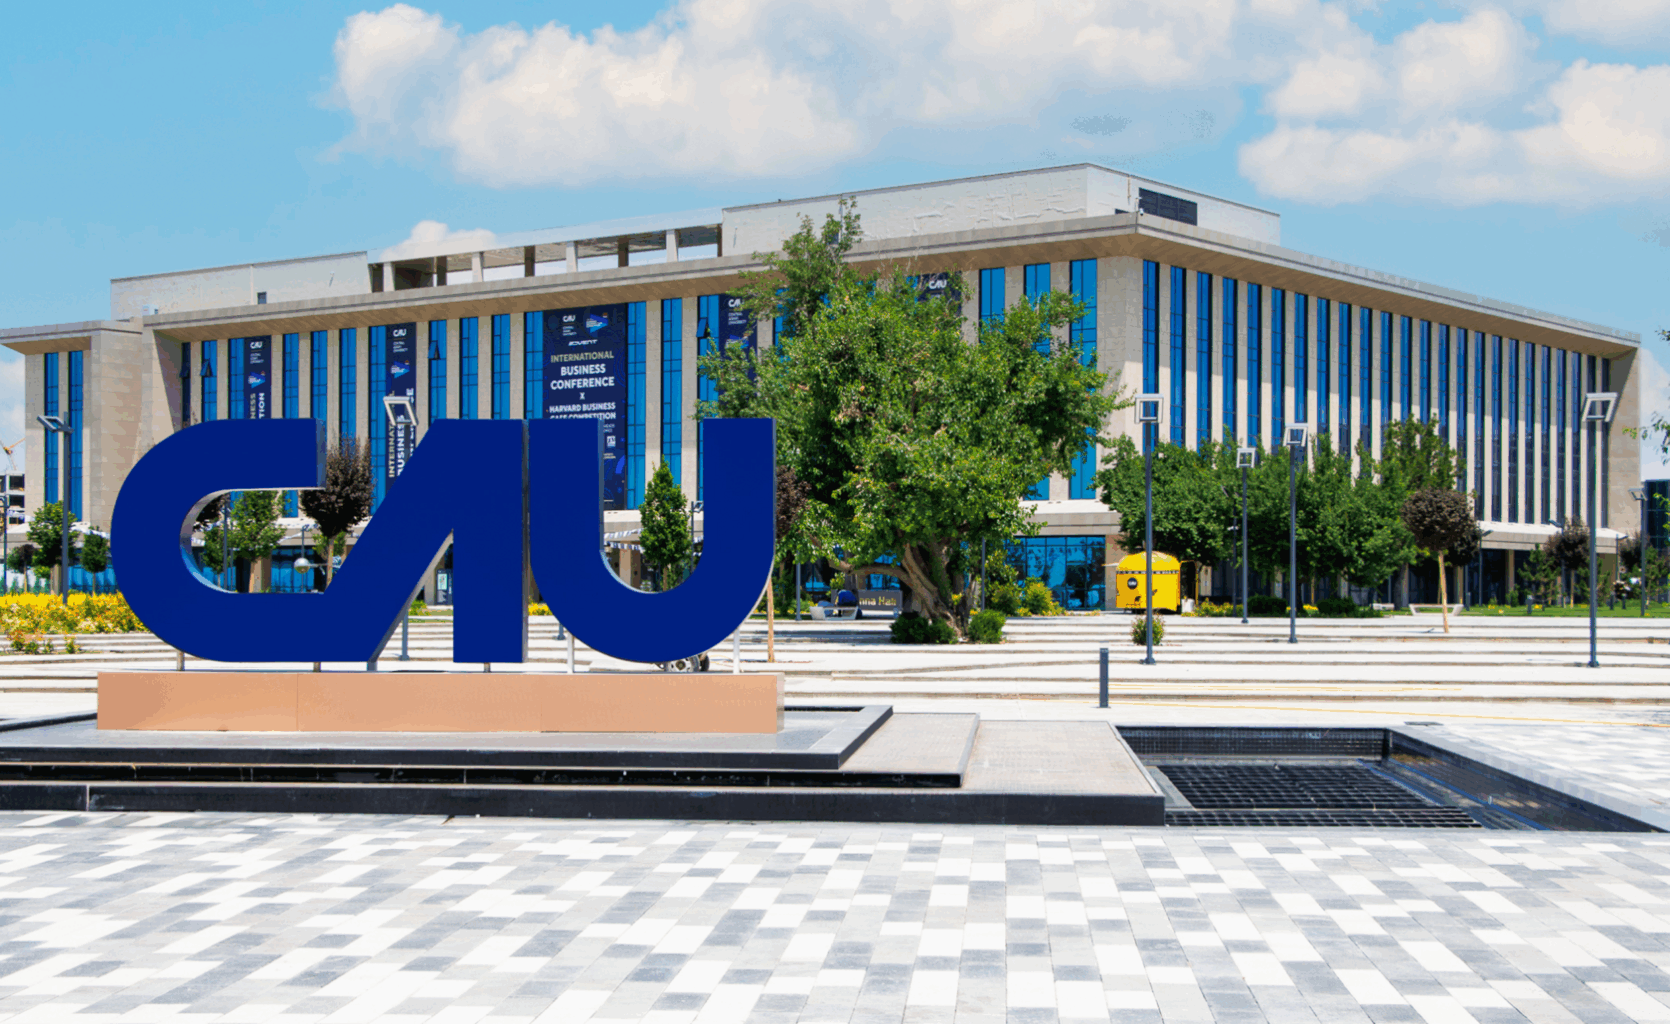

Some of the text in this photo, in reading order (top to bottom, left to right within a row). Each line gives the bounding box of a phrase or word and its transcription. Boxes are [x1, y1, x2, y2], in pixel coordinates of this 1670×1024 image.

[928, 280, 947, 289] CAU
[393, 329, 406, 337] CAU
[550, 350, 615, 363] INTERNATIONAL
[560, 363, 606, 376] BUSINESS
[550, 376, 615, 390] CONFERENCE
[549, 401, 616, 413] HARVARD BUSINESS
[111, 417, 776, 663] CAU
